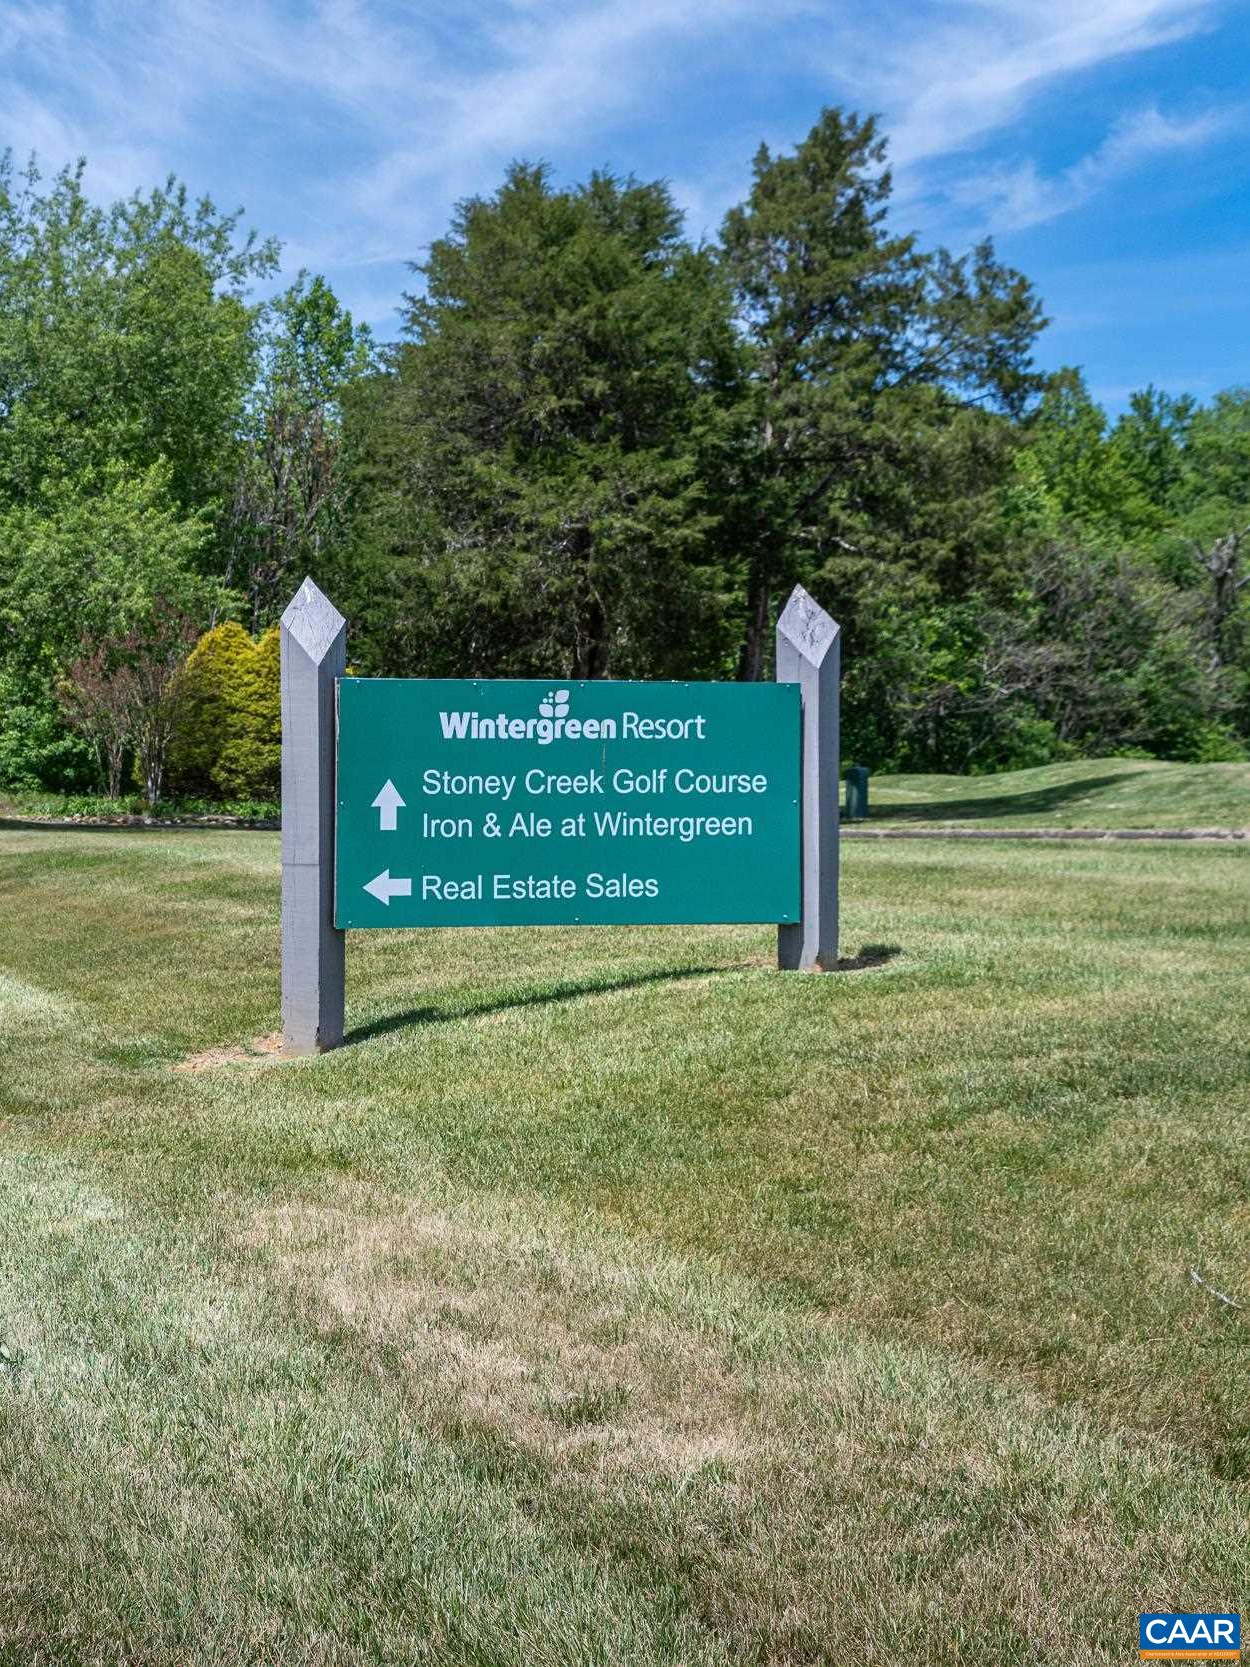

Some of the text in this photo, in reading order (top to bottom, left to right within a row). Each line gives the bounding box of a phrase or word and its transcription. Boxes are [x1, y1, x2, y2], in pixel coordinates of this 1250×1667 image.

[439, 711, 706, 745] Wintergreen Resort
[422, 768, 767, 801] Stoney Creek Golf Course
[423, 811, 752, 842] Iron & Ale at Wintergreen
[422, 872, 659, 900] Real Estate Sales
